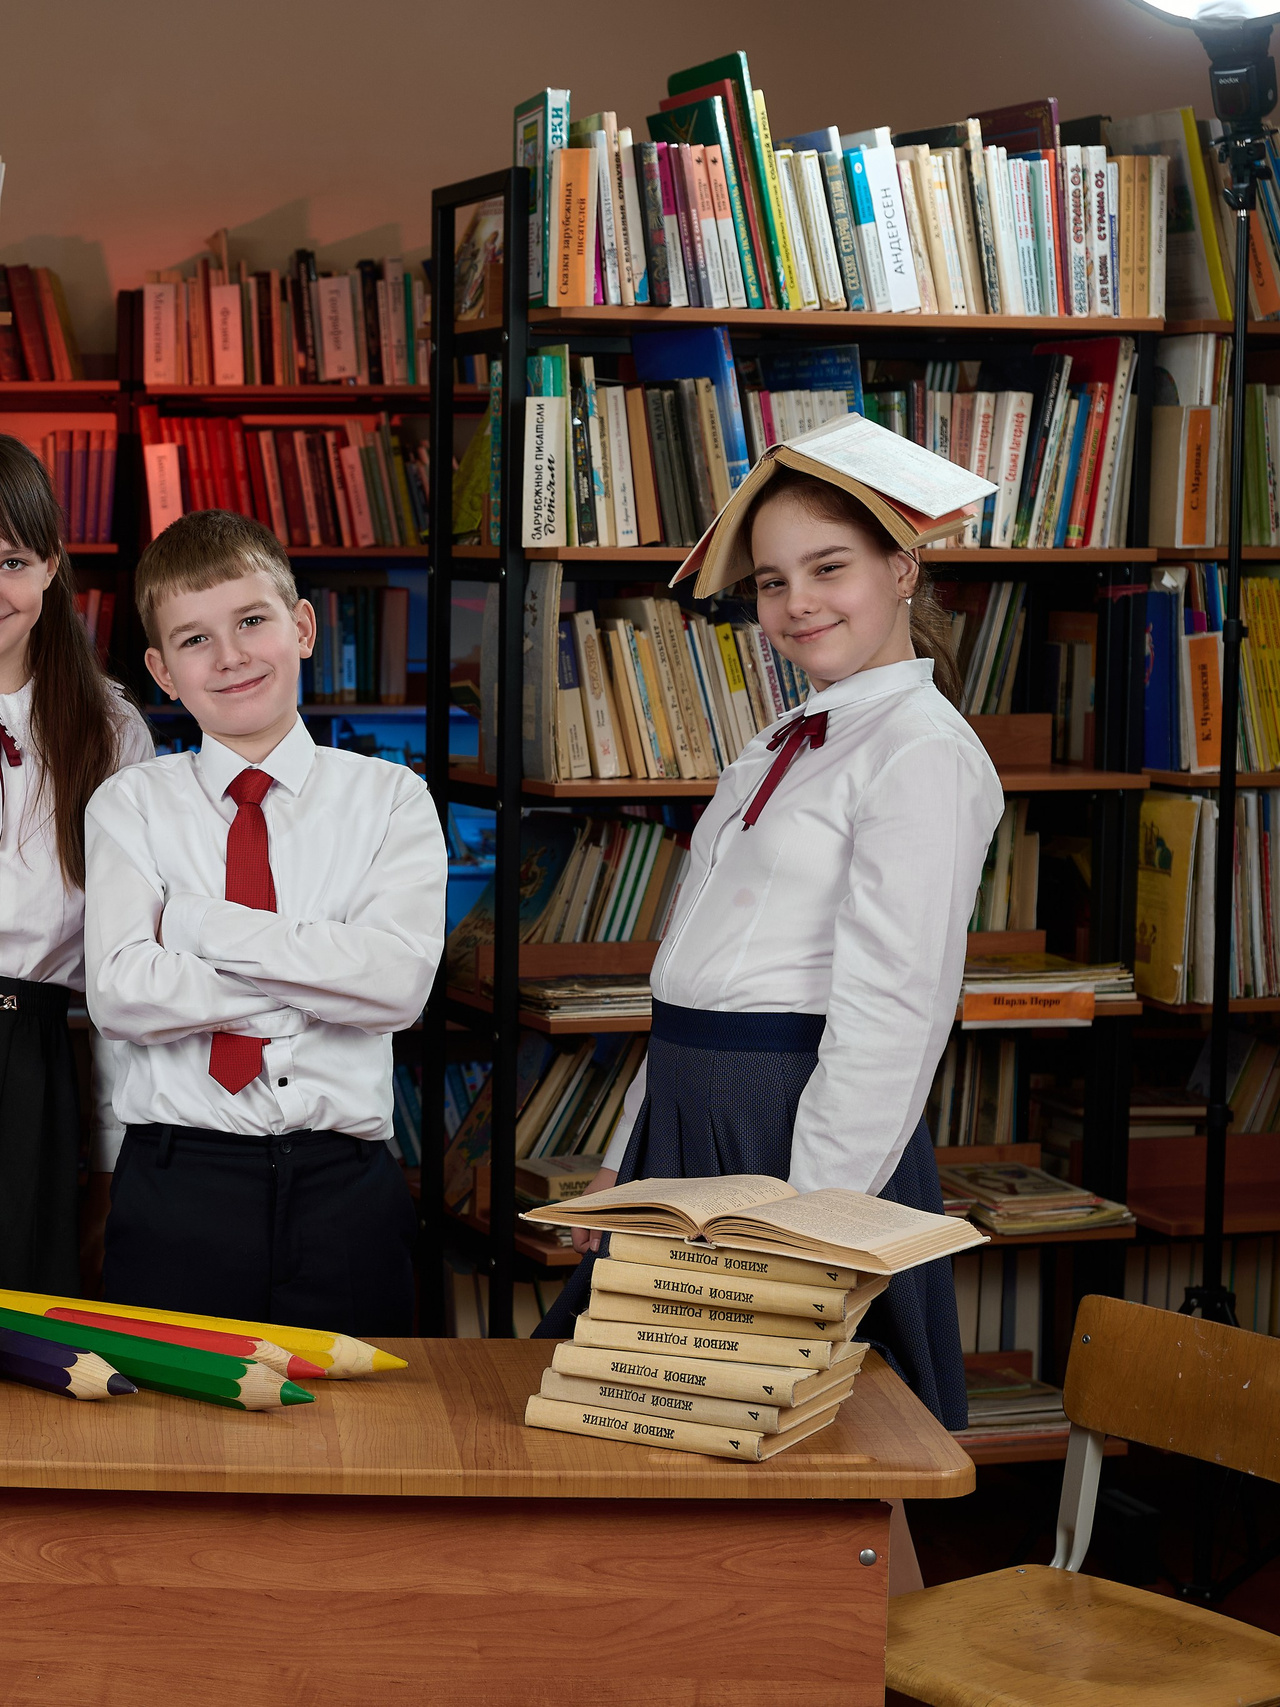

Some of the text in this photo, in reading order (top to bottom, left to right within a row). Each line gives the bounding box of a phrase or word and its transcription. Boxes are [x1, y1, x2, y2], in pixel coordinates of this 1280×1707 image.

[600, 196, 618, 238] СКАЗКИ
[613, 150, 631, 261] ВОЛШЕБНЫЙ СУНДУЧОК
[691, 207, 700, 230] СКАЗКЕ
[758, 108, 797, 288] Сказки зарубежных писателей СОЛОВЕЙ И РОЗА
[1069, 163, 1083, 243] СТРАНА ОЗ
[1095, 169, 1106, 240] СТРАНА ОЗ
[559, 180, 574, 295] Сказки зарубежных
[575, 196, 586, 255] писателей
[827, 179, 860, 291] СКАЗКИ СТАРОЙ АНГЛИИ
[881, 187, 906, 275] АНДЕРСЕН
[695, 240, 705, 267] СКАЗКИ
[699, 270, 706, 278] ОТ
[154, 291, 164, 364] Математика
[222, 307, 230, 351] Физика
[328, 289, 342, 352] География
[651, 396, 665, 440] МАУГЛИ
[708, 406, 720, 448] КИПЛИНГ
[975, 412, 992, 476] ельма Лагерлёф
[1004, 410, 1027, 482] Сельма Лагерлёф
[158, 456, 168, 510] Биология
[1191, 443, 1202, 511] С. Маршак
[531, 466, 544, 540] ЗАРУБЕЖНЫЕ
[584, 641, 600, 689] СКАЗКИ
[1198, 662, 1213, 741] К. Чуковский
[993, 995, 1061, 1007] Шарль Перро
[669, 1249, 768, 1274] ЖИВОЙ РОДНИК
[826, 1272, 839, 1282] 4
[653, 1278, 754, 1304] ЖИВОЙ РОДНИК
[812, 1303, 825, 1313] 4
[652, 1303, 754, 1326] ЖИВОЙ РОДНИК
[814, 1321, 826, 1332] 4
[636, 1330, 739, 1352] ЖИВОЙ РОДНИК
[798, 1348, 812, 1358] 4
[611, 1361, 707, 1388] ЖИВОЙ РОДНИК
[762, 1384, 774, 1396] 4
[598, 1386, 694, 1412] ЖИВОЙ РОДНИК
[748, 1410, 760, 1421] 4
[582, 1413, 675, 1440] ЖИВОЙ РОДНИК
[729, 1440, 740, 1450] 4
